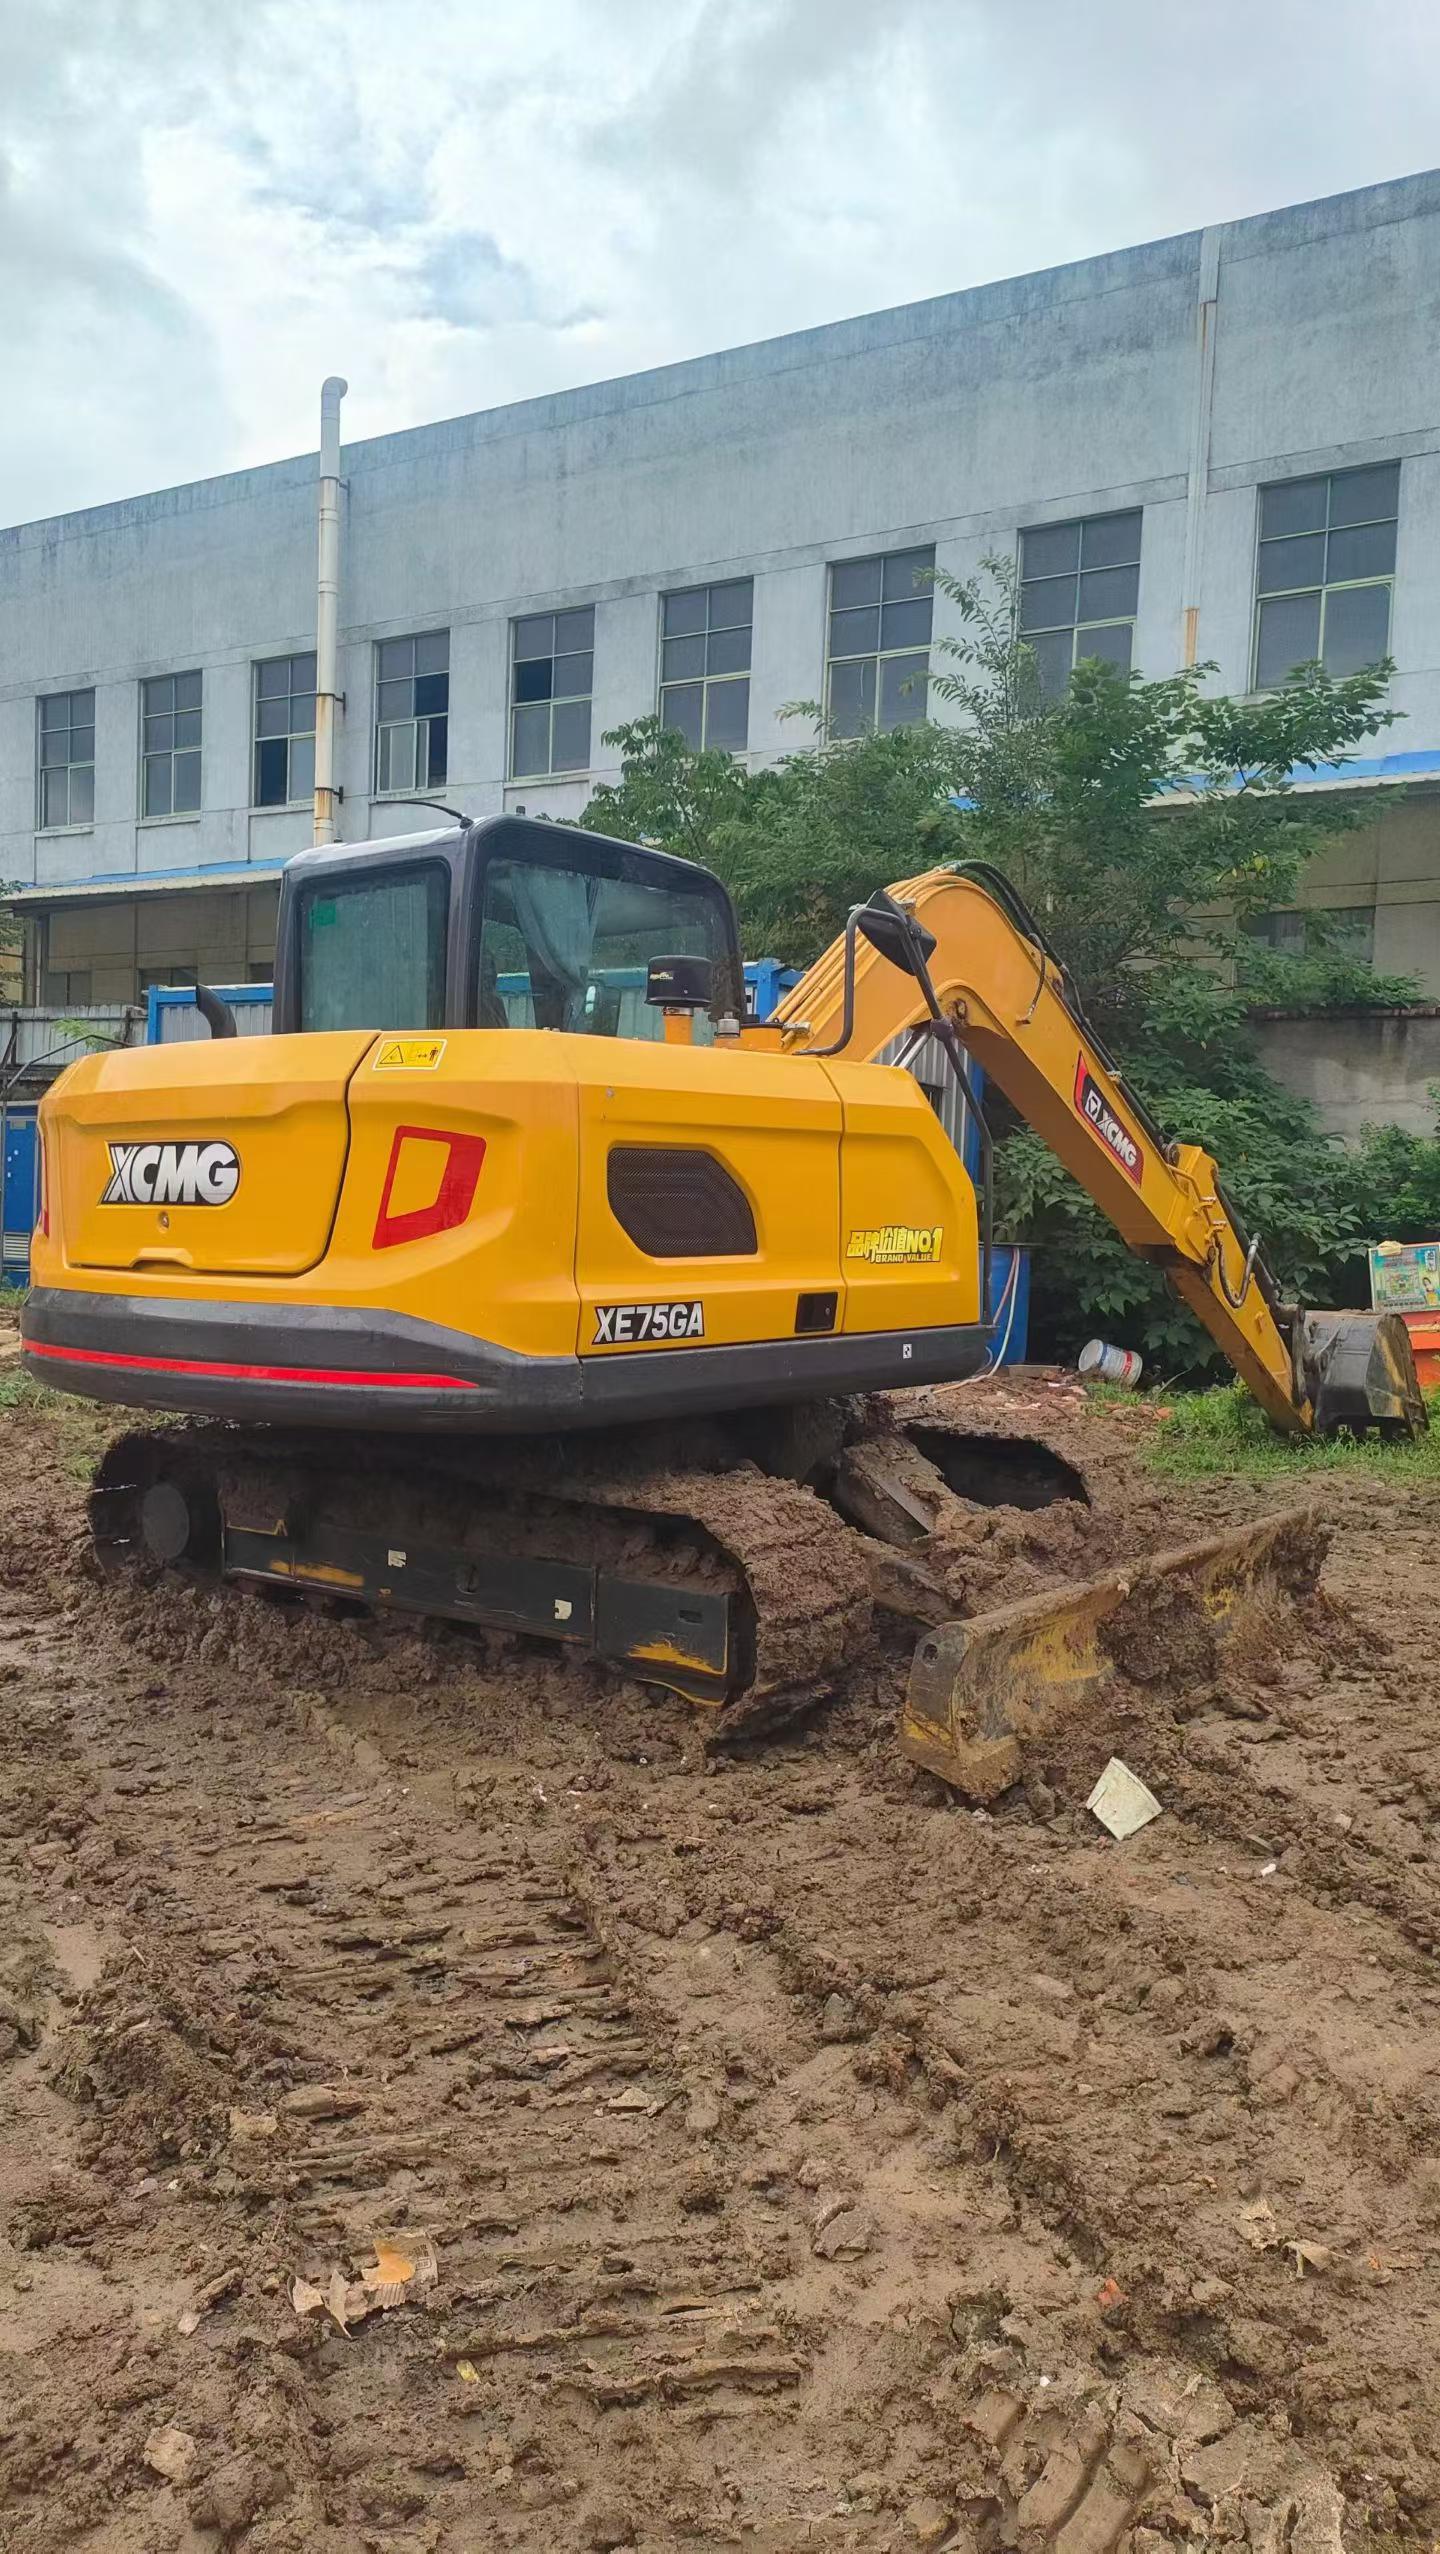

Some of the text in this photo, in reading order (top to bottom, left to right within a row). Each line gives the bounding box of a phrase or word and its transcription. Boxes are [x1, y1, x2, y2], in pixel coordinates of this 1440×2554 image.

[1096, 1108, 1137, 1167] XCMG
[102, 1143, 239, 1204] XCMG
[875, 1253, 932, 1263] BRAND VALUE
[594, 1303, 704, 1343] XE75GA
